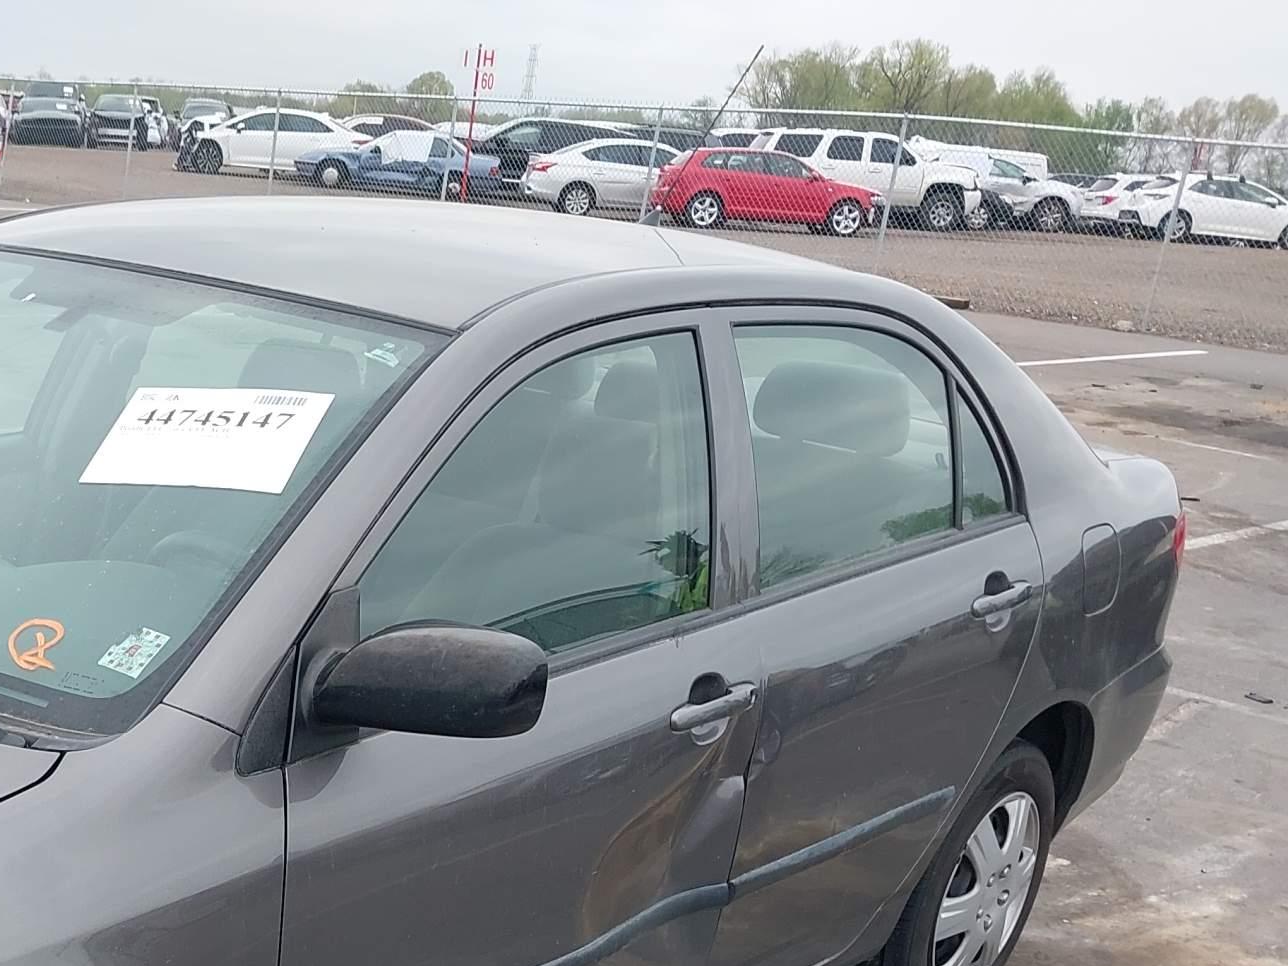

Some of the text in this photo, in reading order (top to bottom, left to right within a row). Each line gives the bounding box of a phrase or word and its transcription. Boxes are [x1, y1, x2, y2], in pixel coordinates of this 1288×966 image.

[483, 50, 495, 67] H
[481, 73, 495, 90] 60
[136, 408, 297, 429] 44745147
